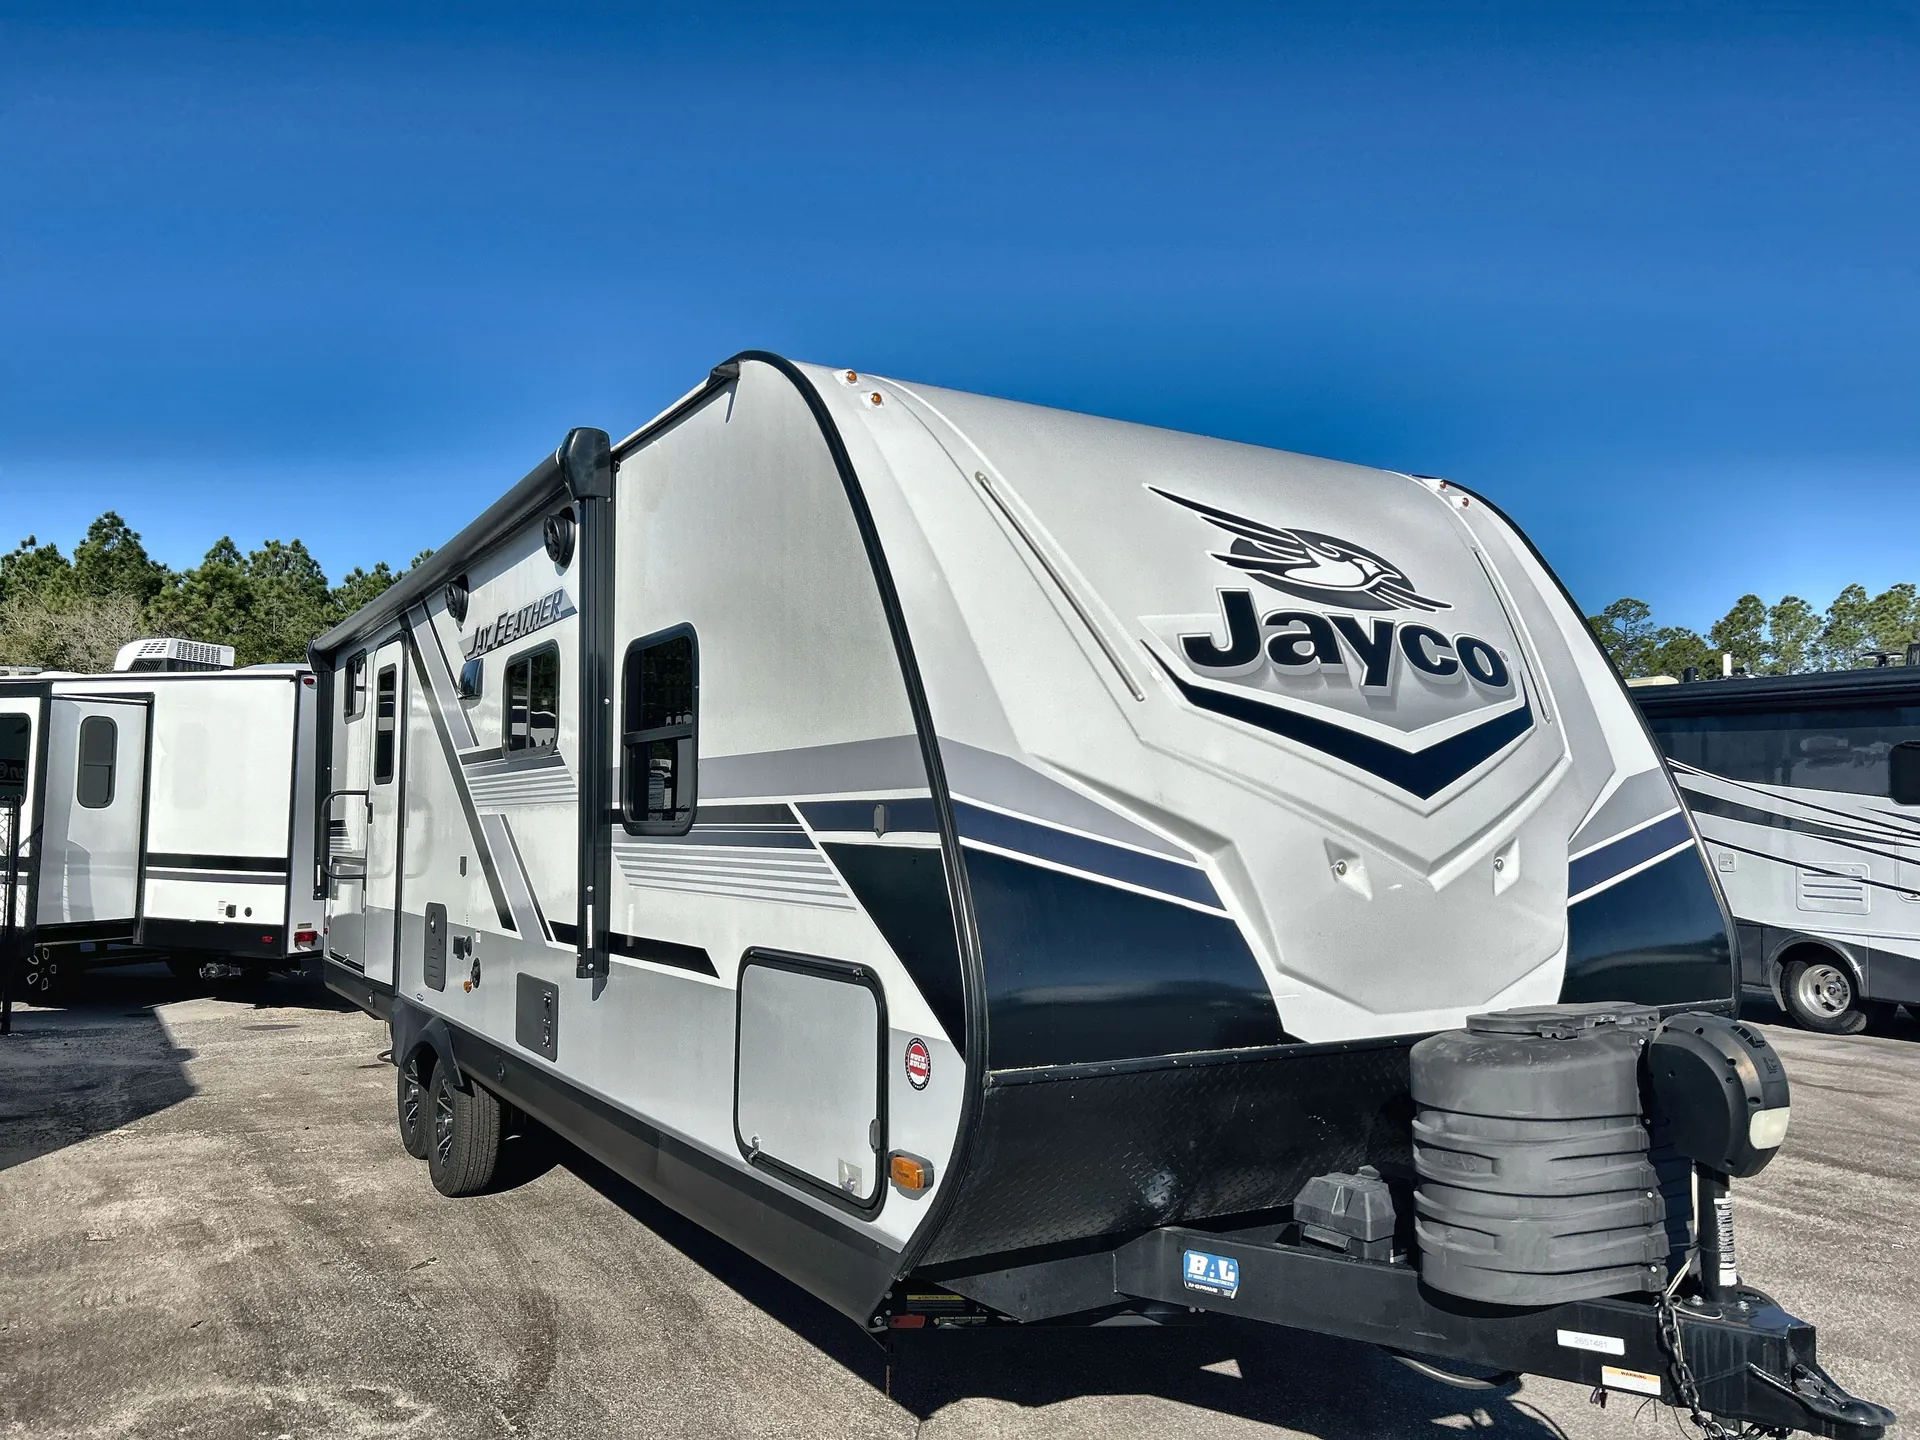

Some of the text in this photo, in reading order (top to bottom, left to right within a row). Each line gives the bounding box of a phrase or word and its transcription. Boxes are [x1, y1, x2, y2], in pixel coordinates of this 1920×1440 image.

[464, 587, 565, 658] JAY FEATHER
[1179, 587, 1513, 694] Jayco
